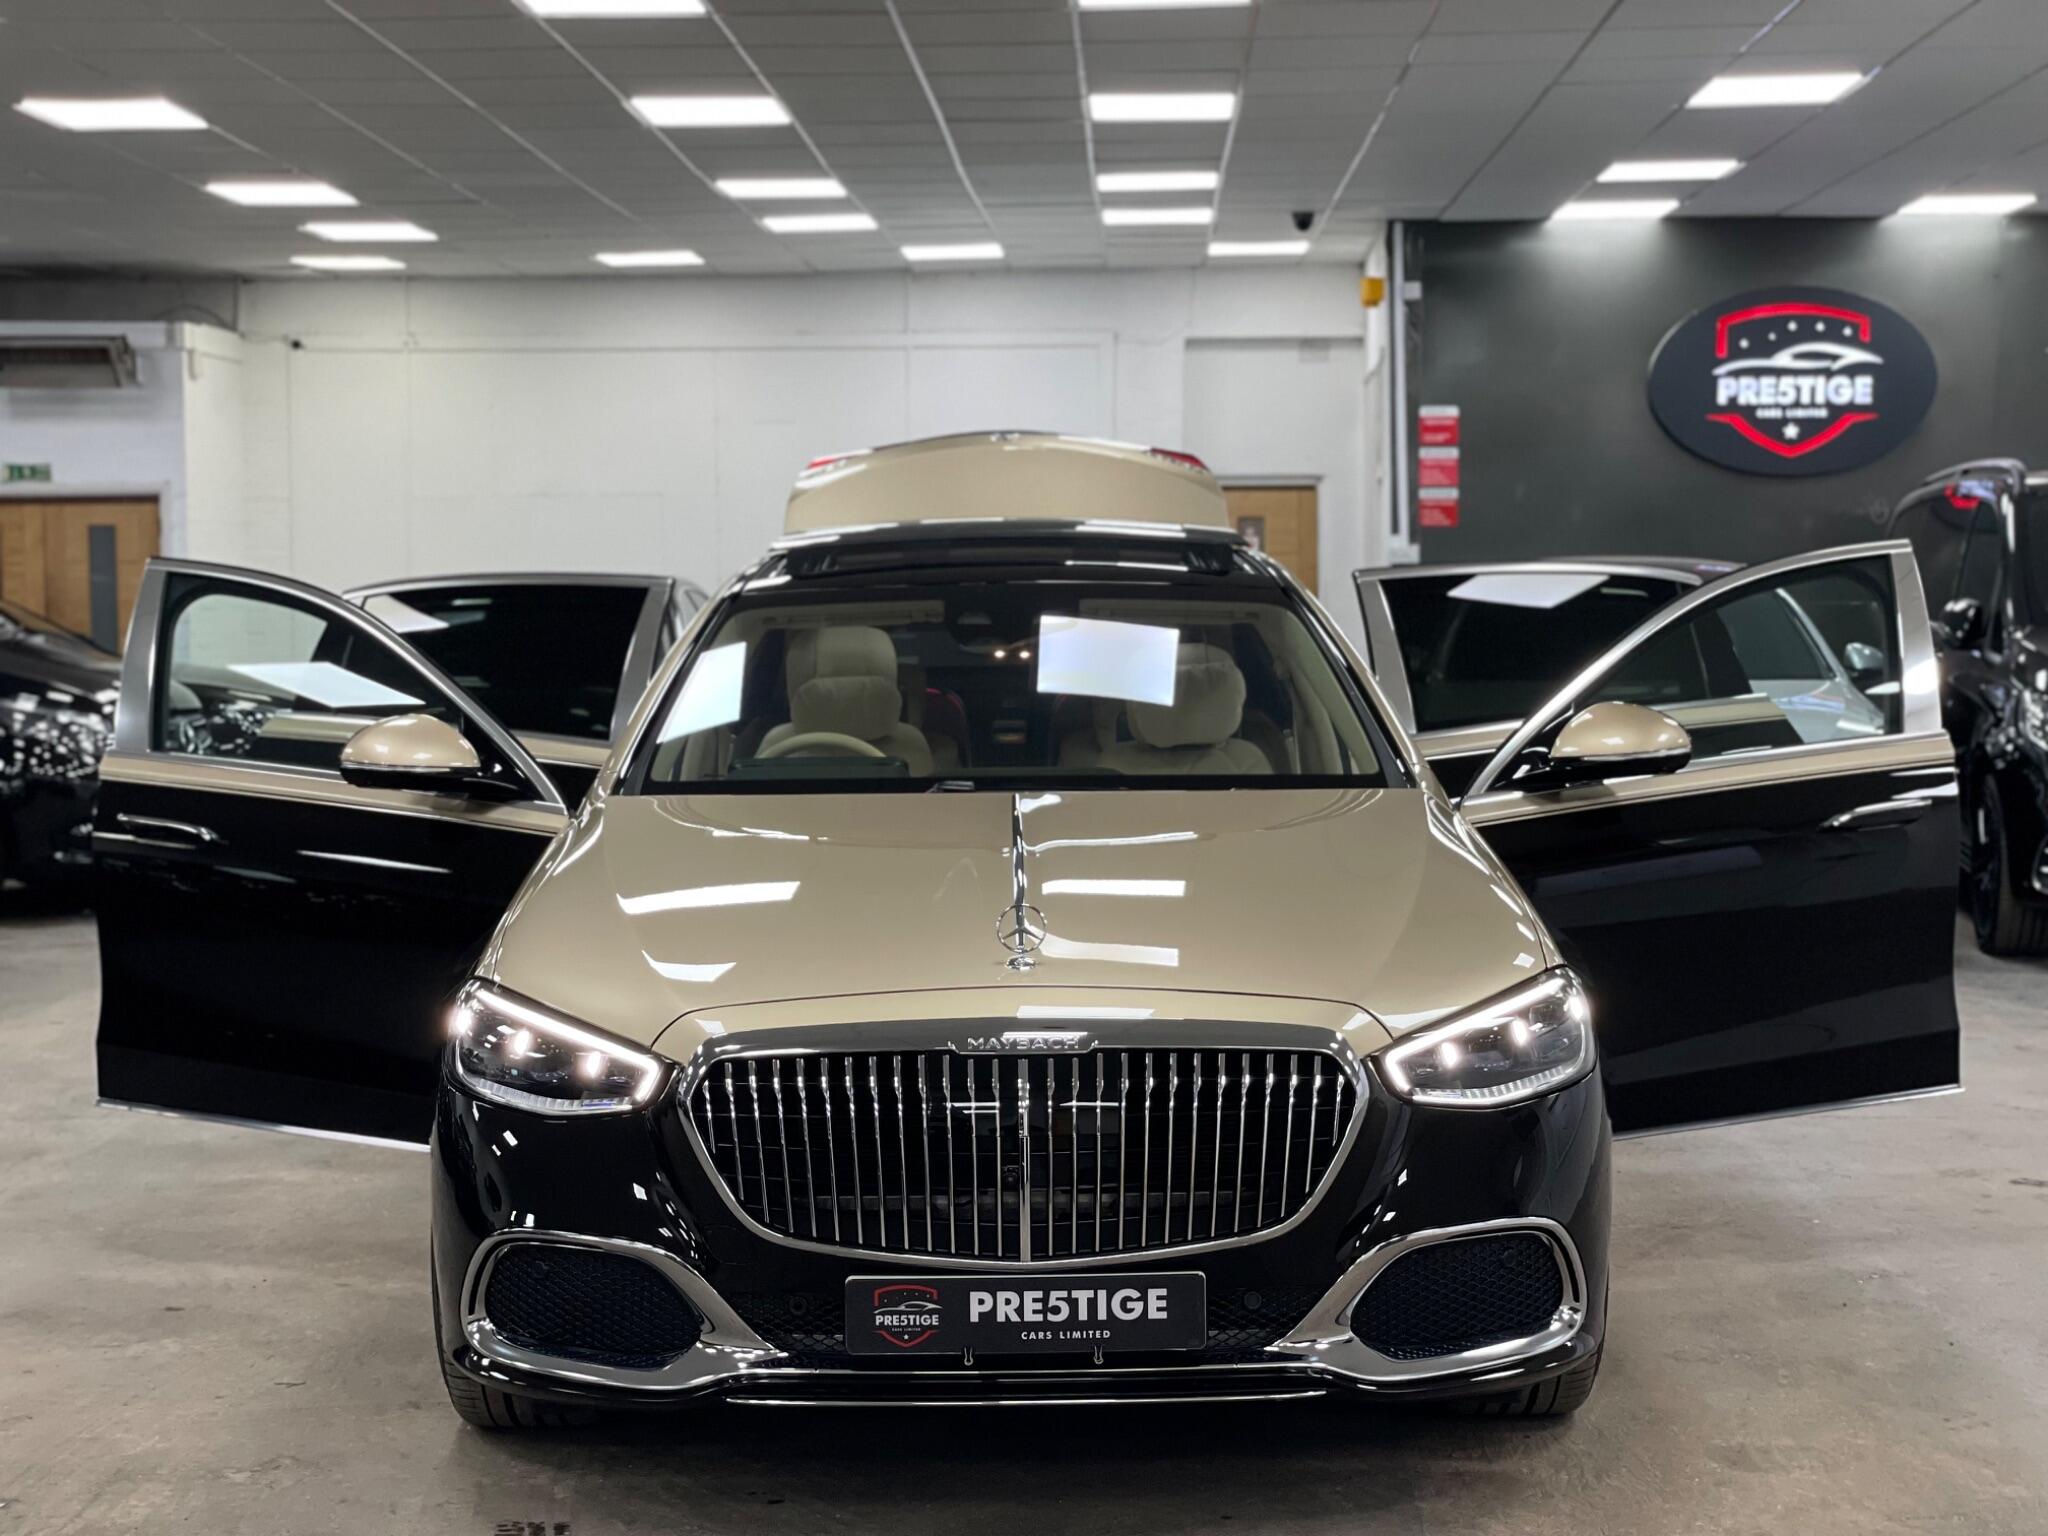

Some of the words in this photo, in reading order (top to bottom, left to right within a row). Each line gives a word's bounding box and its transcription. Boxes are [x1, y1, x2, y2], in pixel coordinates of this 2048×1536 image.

[1715, 375, 1874, 406] PRE5TIGE
[967, 1036, 1080, 1050] MAYBACH
[969, 1288, 1168, 1323] PRE5TIGE
[875, 1314, 940, 1326] PRE5TIGE
[1021, 1331, 1053, 1340] CARS
[1059, 1330, 1111, 1339] LIMITED
